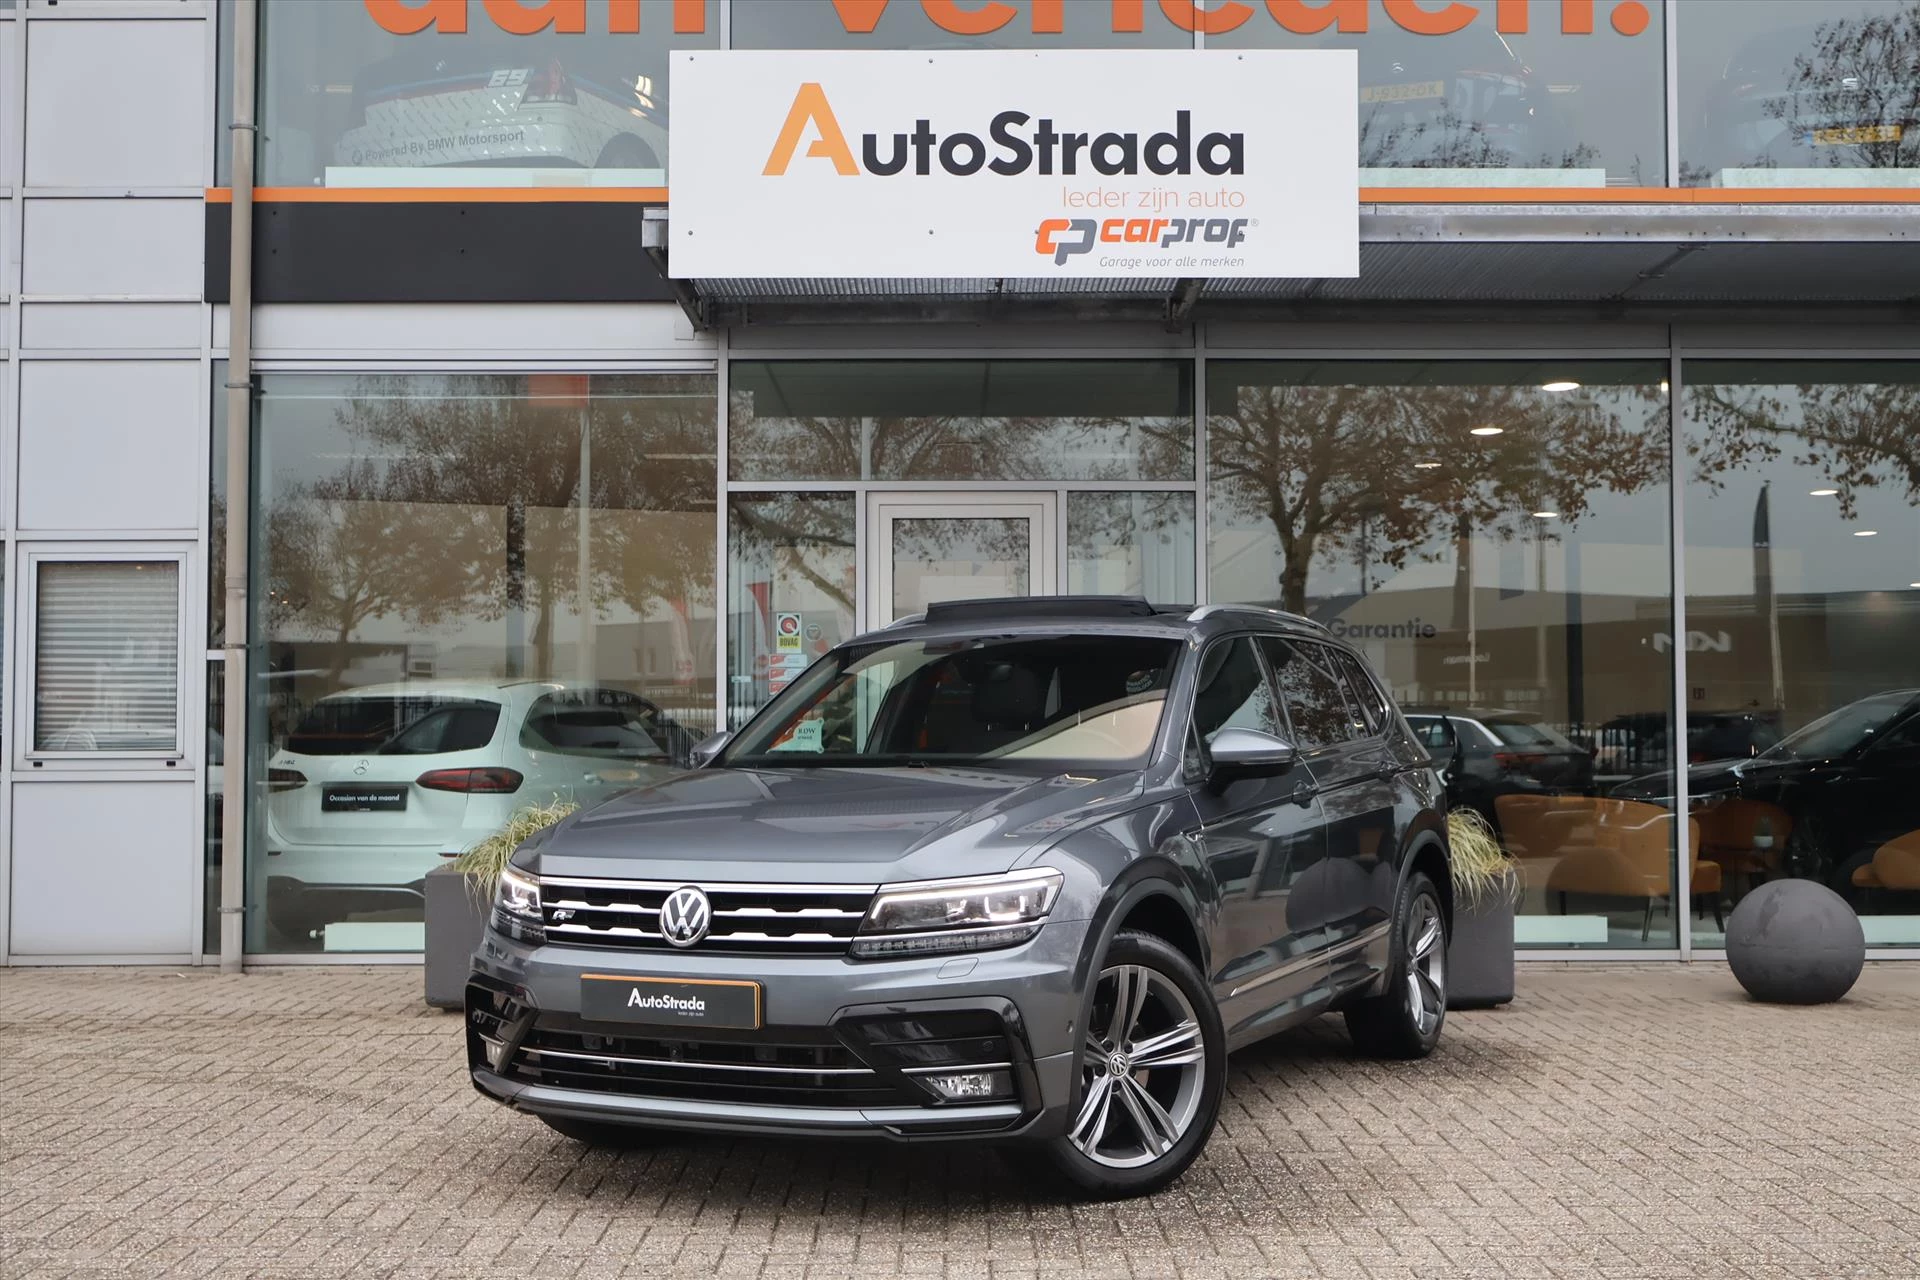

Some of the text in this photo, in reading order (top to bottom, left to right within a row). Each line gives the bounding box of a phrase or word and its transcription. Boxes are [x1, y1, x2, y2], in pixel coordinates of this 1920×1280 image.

[761, 82, 1244, 176] AutoStrada
[365, 130, 525, 161] Powered By BMW Motorsport
[1062, 186, 1245, 213] Ieder zijn auto
[1099, 256, 1245, 269] Garage voor alle merken
[1327, 617, 1437, 638] Garantie
[779, 638, 799, 647] BOVAG
[329, 794, 356, 802] Occasion
[378, 794, 400, 802] maand
[627, 987, 705, 1011] AutoStrada
